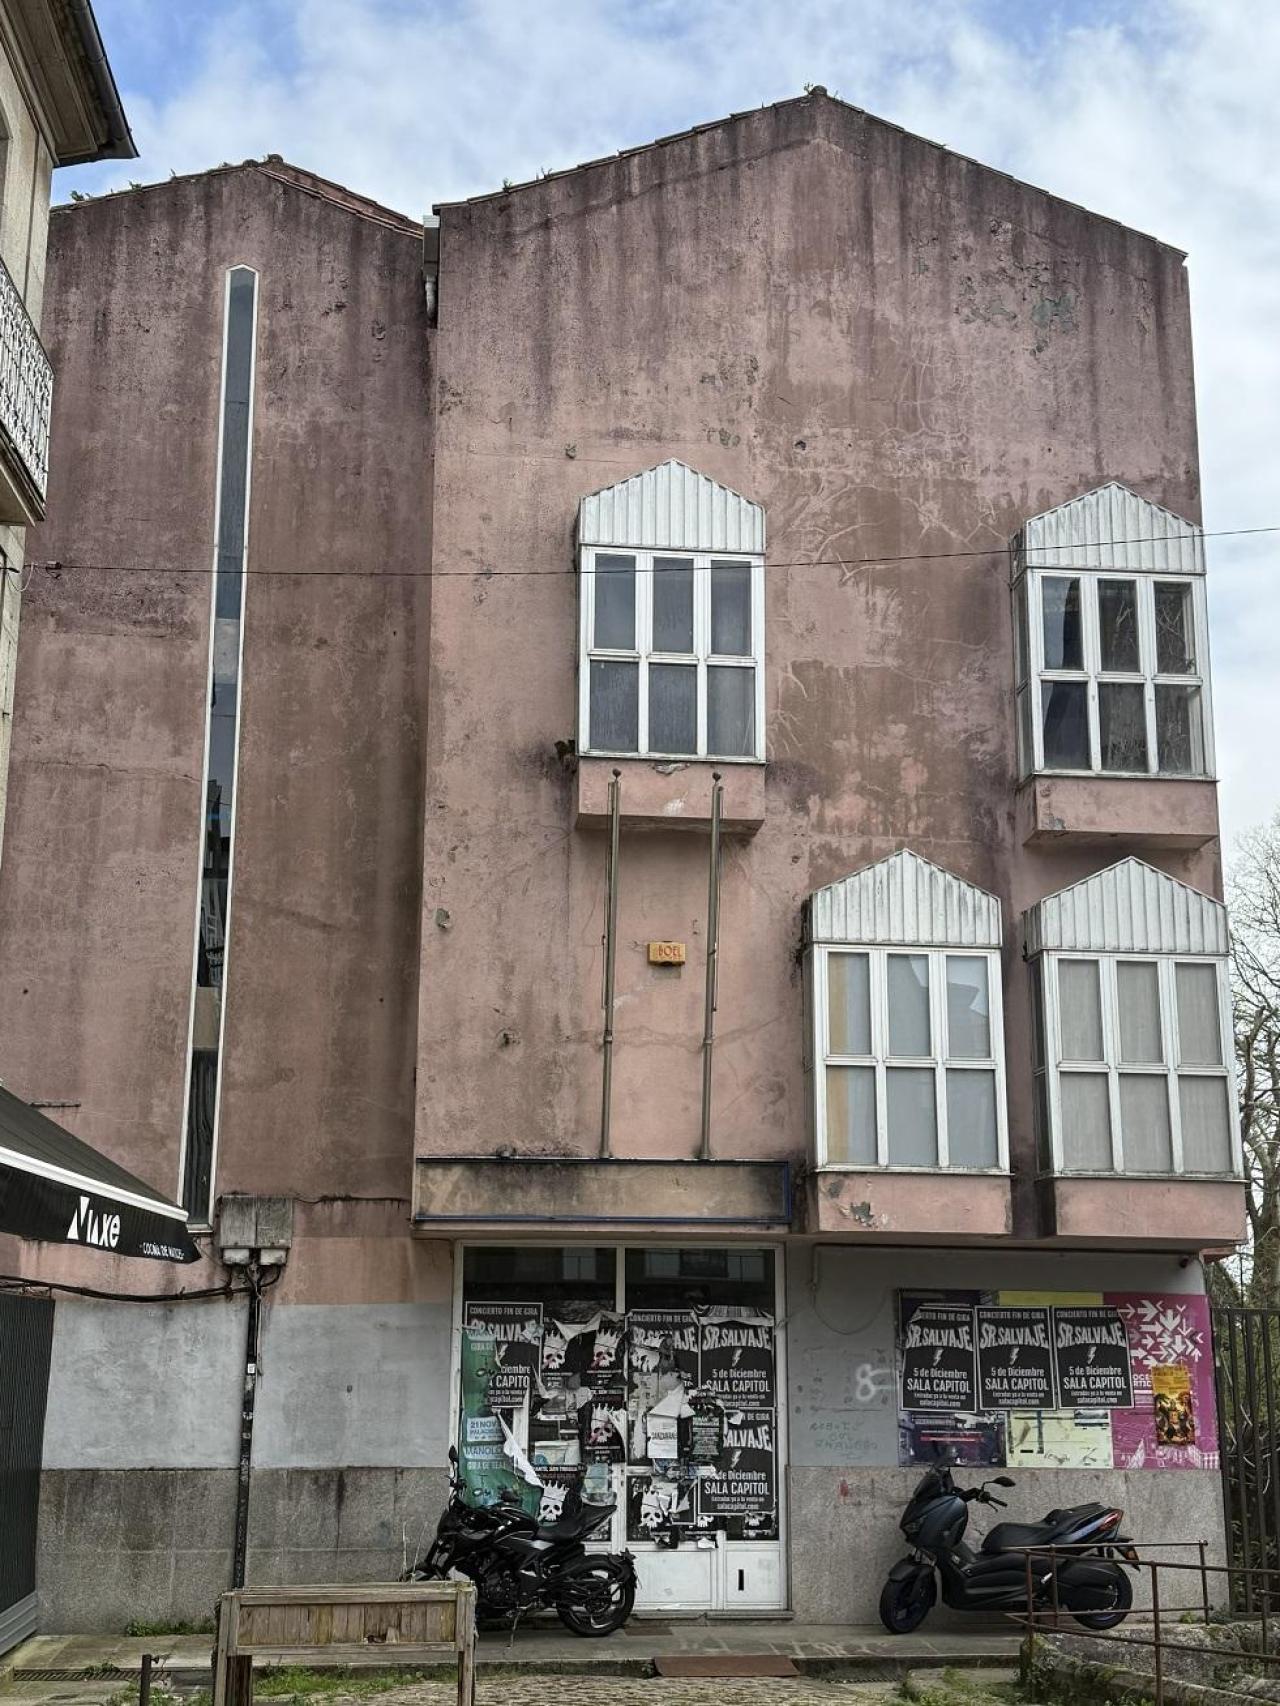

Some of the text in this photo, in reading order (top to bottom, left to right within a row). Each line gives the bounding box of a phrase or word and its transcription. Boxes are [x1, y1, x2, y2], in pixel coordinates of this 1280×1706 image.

[719, 1368, 728, 1378] de
[729, 1368, 767, 1378] Diciembre
[920, 1367, 929, 1378] de
[930, 1368, 967, 1379] Diciembre
[997, 1366, 1007, 1377] de
[1008, 1366, 1044, 1377] Diciembre
[1075, 1365, 1085, 1375] de
[1086, 1365, 1122, 1376] Diciembre
[495, 1375, 531, 1388] CAPITO
[706, 1380, 730, 1392] SALA
[732, 1380, 771, 1392] CAPITOL
[907, 1377, 972, 1393] SALA CAPITOL
[985, 1377, 1049, 1391] SALA CAPITOL
[1064, 1377, 1127, 1390] SALA CAPITOL
[728, 1470, 767, 1480] Diciembre
[704, 1482, 769, 1495] SALA CAPITOL
